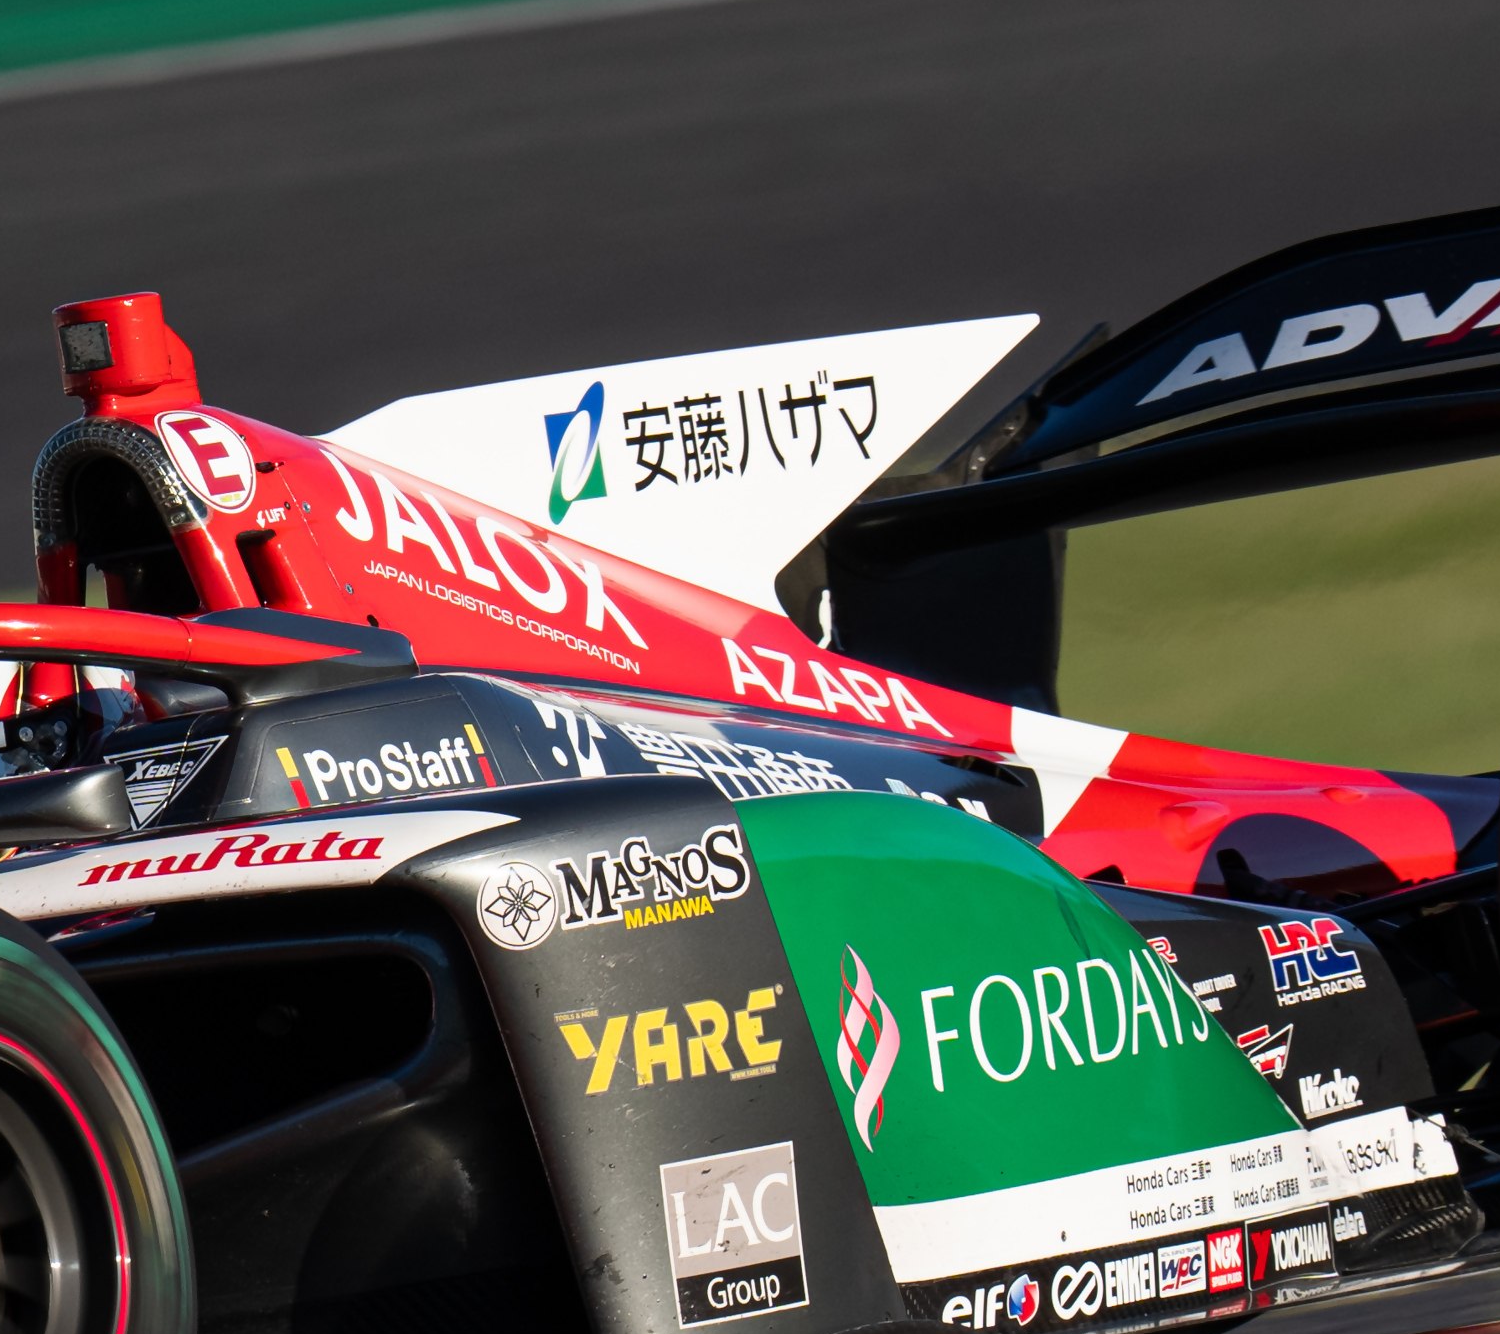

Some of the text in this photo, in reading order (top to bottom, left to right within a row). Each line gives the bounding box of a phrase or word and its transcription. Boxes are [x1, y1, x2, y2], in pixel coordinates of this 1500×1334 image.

[622, 369, 878, 492] 安藤ハザマ
[166, 417, 246, 496] E
[265, 507, 287, 523] LIFT
[319, 449, 649, 649] JALOX
[364, 560, 641, 675] JAPAN LOGISTICS CORPORATION
[721, 638, 953, 738] AZAPA
[125, 759, 195, 782] XEBEC
[78, 831, 385, 887] muRata
[625, 894, 715, 930] MANAWA
[1257, 918, 1362, 992] HRC
[1277, 975, 1367, 1007] Honda RACING
[559, 987, 783, 1095] YARE
[1126, 1171, 1164, 1194] Honda
[1166, 1167, 1189, 1186] Cars
[1230, 1151, 1256, 1173] Honda
[1256, 1148, 1273, 1167] Cars
[671, 1172, 795, 1259] LAC
[1130, 1206, 1167, 1230] Honda
[1169, 1203, 1192, 1222] Cars
[1233, 1187, 1259, 1209] Honda
[1260, 1184, 1276, 1203] Cars
[1209, 1233, 1242, 1272] NGK
[1269, 1222, 1332, 1271] YOKOHAMA
[707, 1274, 781, 1308] Group
[1106, 1252, 1155, 1307] ENKEI
[942, 1285, 1003, 1330] elf
